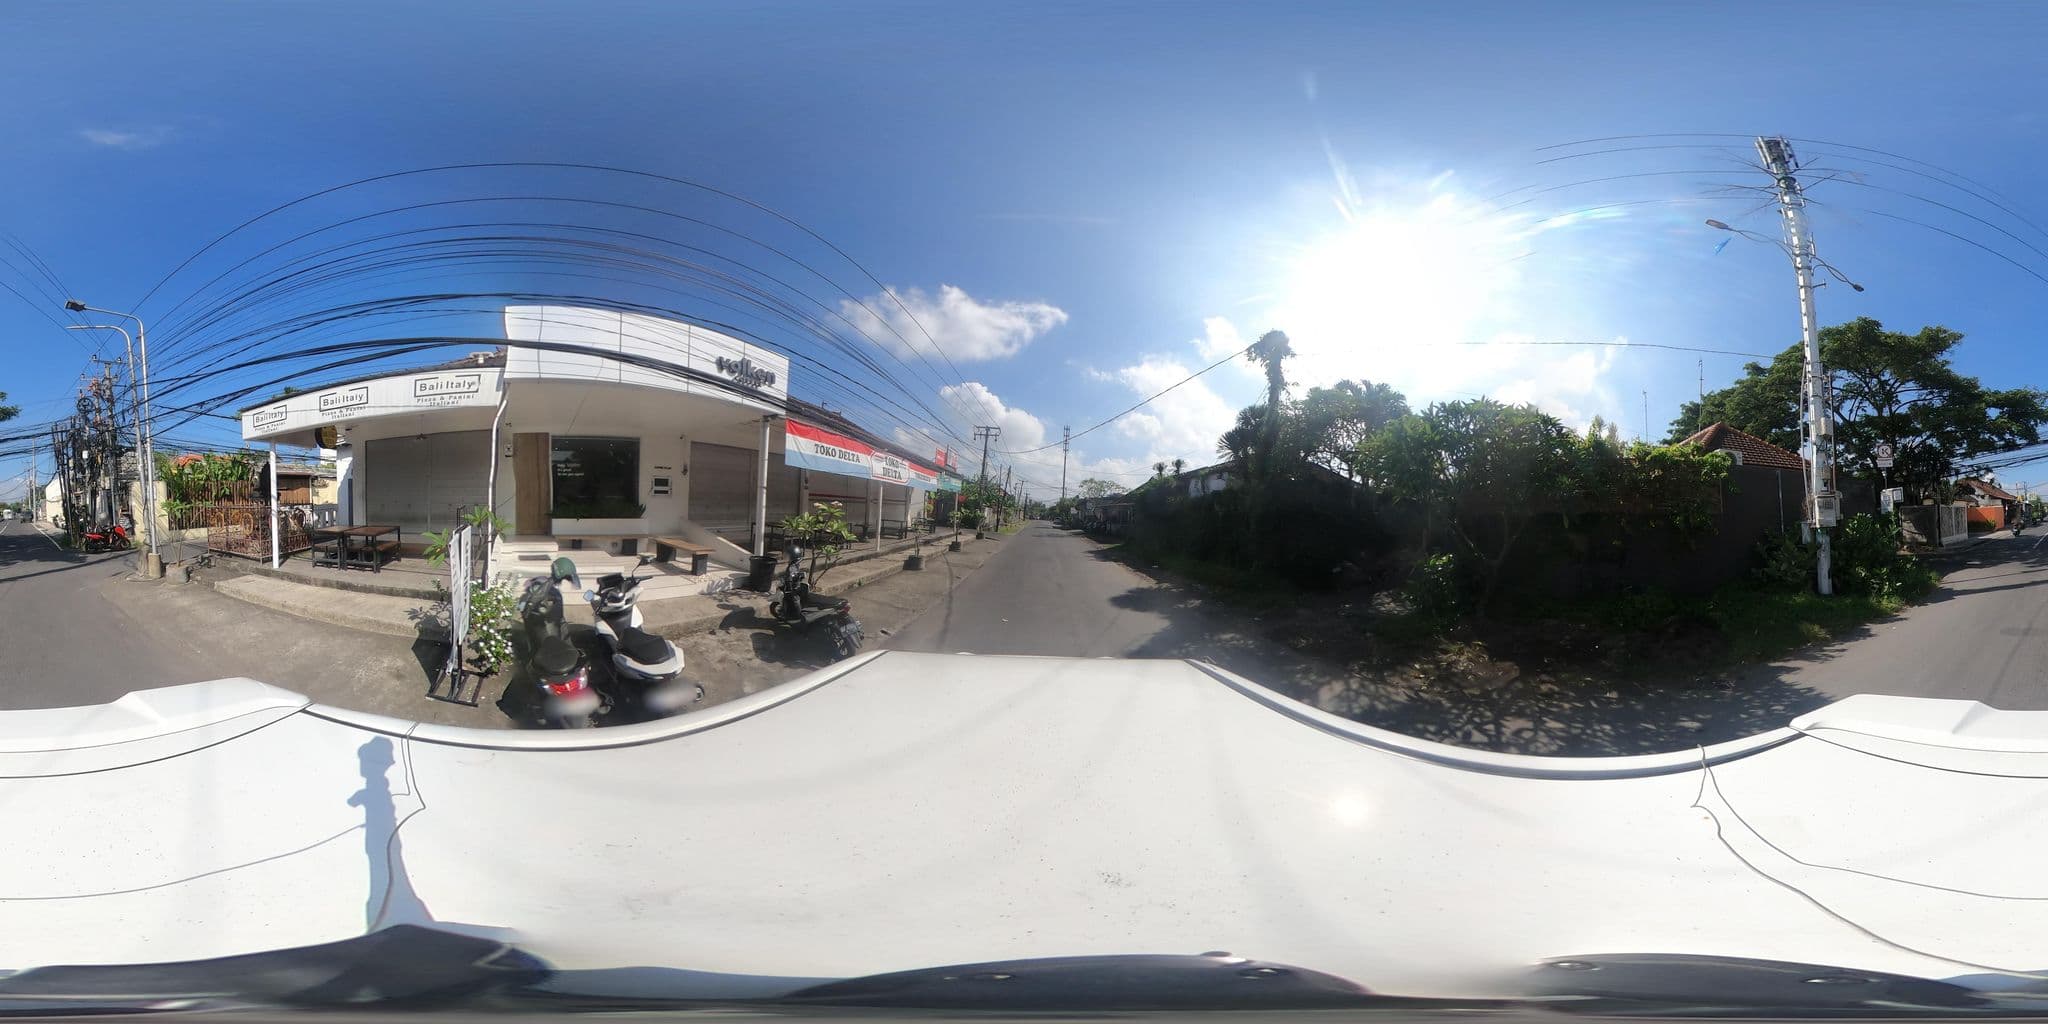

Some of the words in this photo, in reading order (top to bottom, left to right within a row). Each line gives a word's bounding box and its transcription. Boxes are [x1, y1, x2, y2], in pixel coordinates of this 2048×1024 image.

[814, 444, 837, 457] TOKO
[838, 448, 861, 463] DELTA
[882, 466, 903, 481] DELTA
